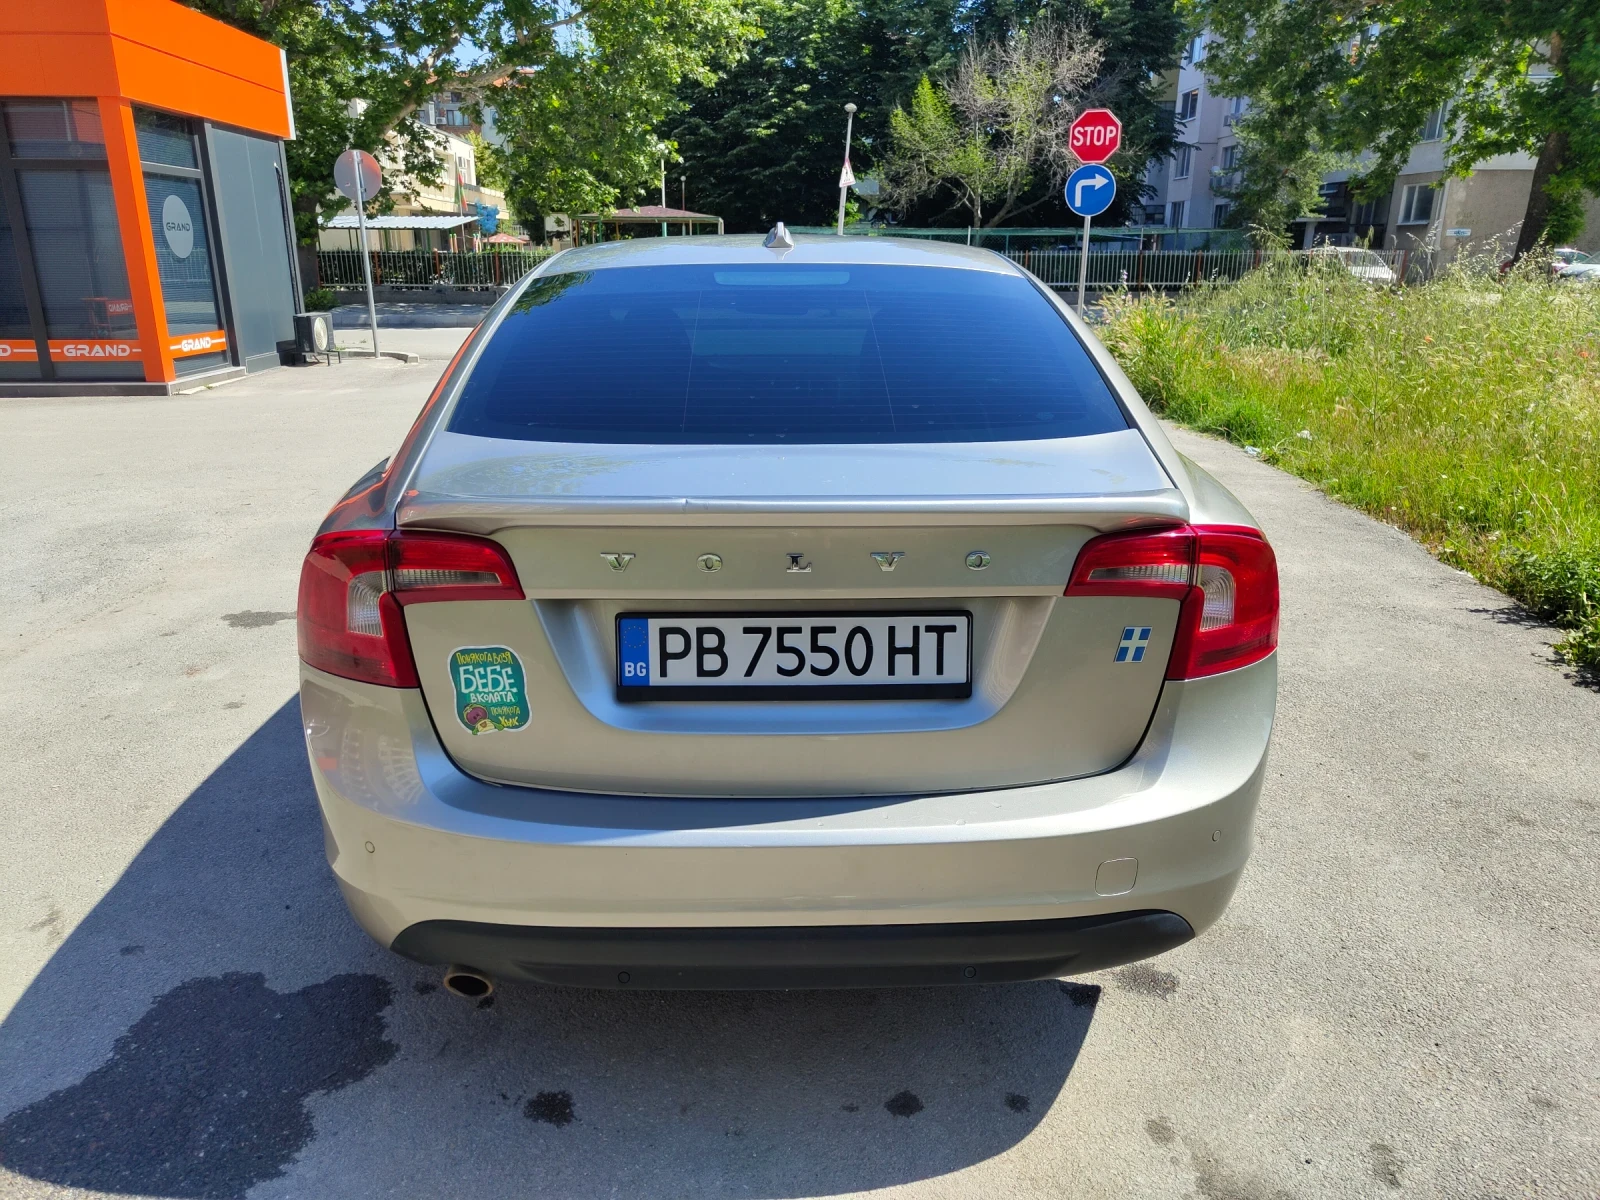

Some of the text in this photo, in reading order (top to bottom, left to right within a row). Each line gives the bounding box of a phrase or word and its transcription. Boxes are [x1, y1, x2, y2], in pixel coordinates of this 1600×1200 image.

[1073, 125, 1116, 147] STOP
[165, 222, 191, 232] GRAND
[63, 344, 131, 357] GRAND
[181, 336, 212, 352] GRAND
[600, 551, 991, 573] VOLVO
[658, 624, 957, 678] PB 7550 HT
[624, 661, 647, 677] BG
[459, 665, 518, 693] БЕБЕ
